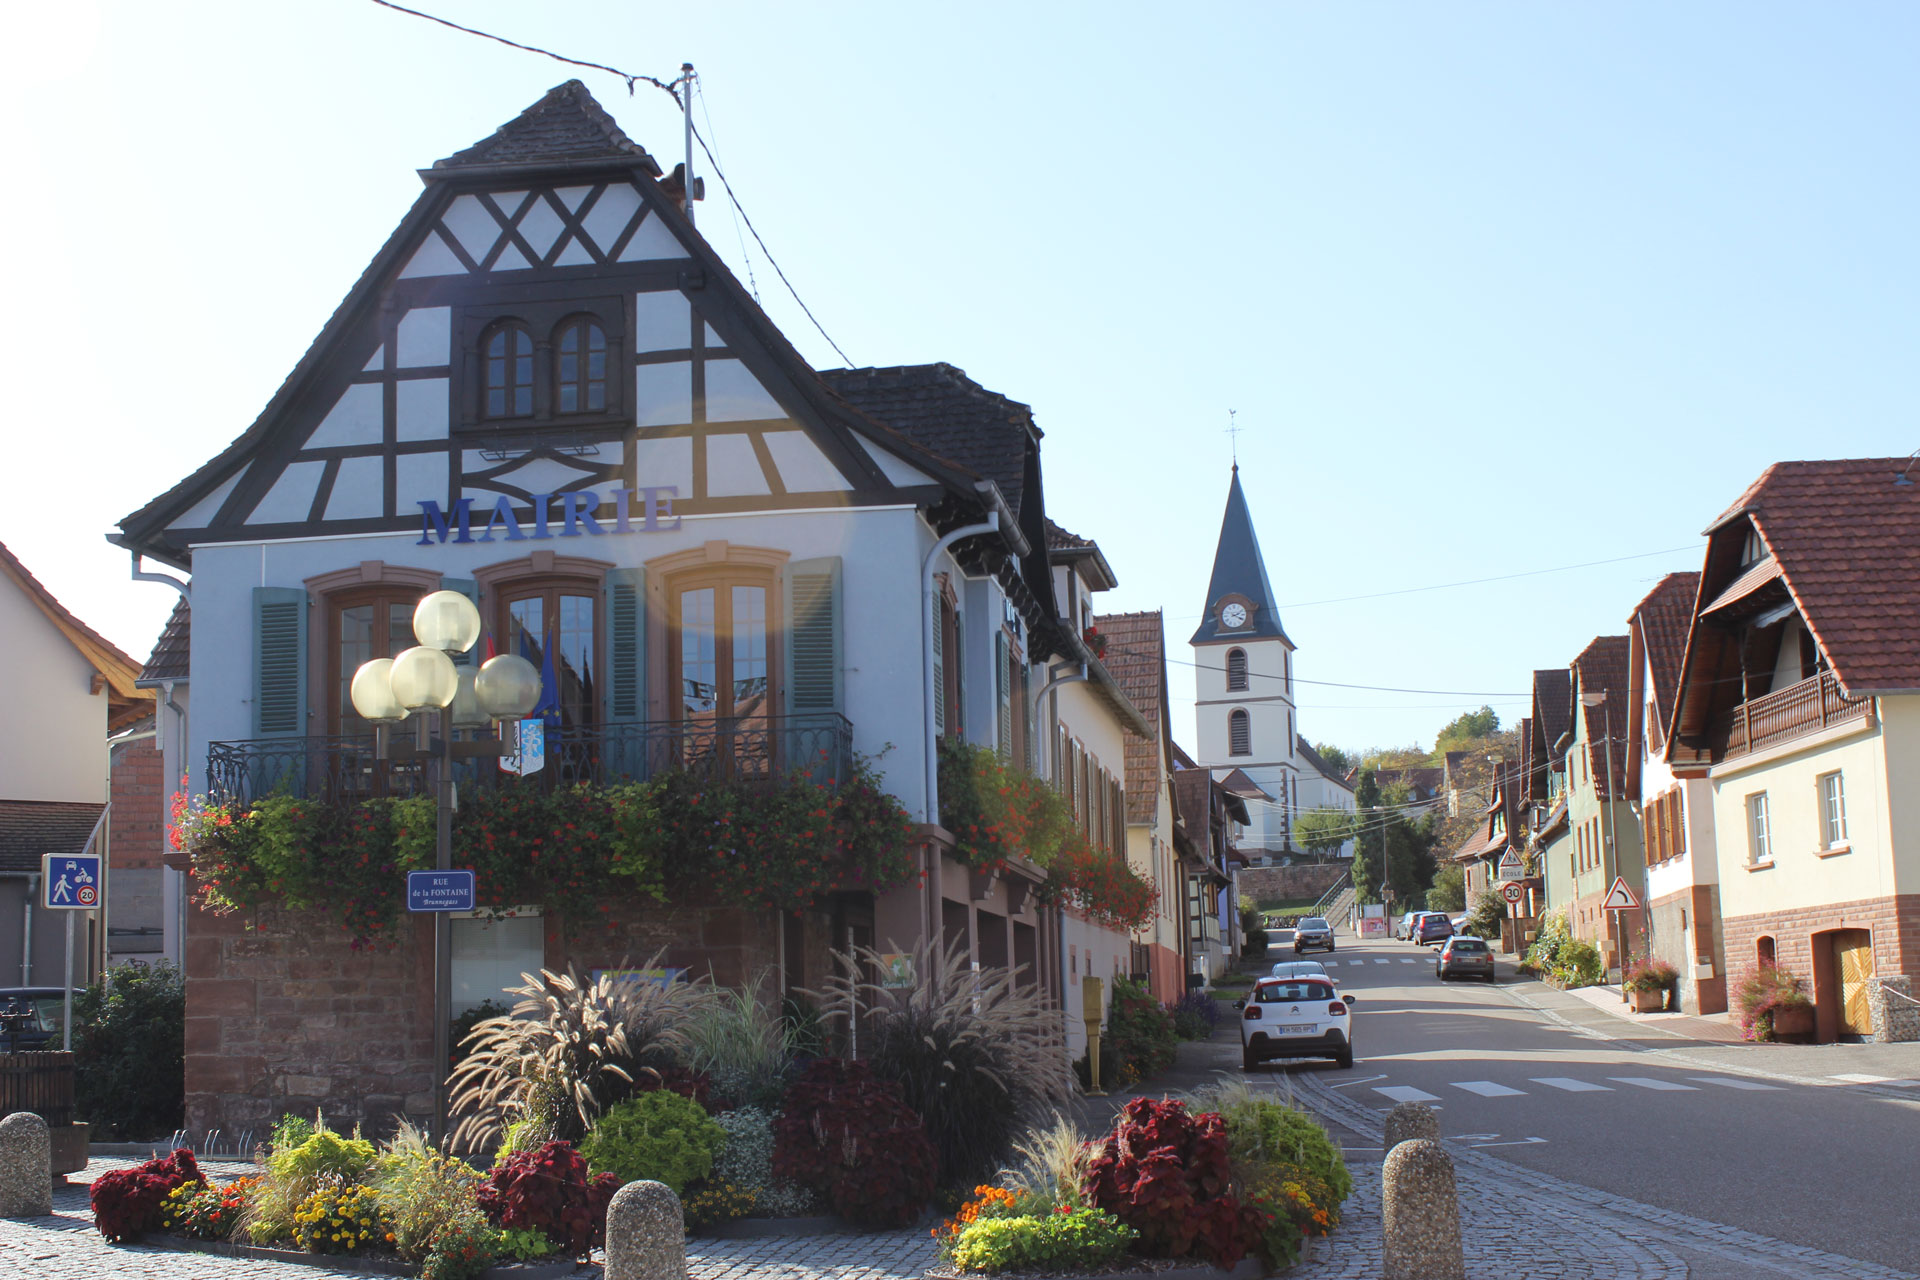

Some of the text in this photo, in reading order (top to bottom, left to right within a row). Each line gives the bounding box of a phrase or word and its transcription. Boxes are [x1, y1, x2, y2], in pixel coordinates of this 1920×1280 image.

[416, 485, 681, 545] MAIRIE
[82, 891, 93, 899] 20
[431, 888, 469, 896] FONTAINE
[1507, 888, 1520, 898] 30
